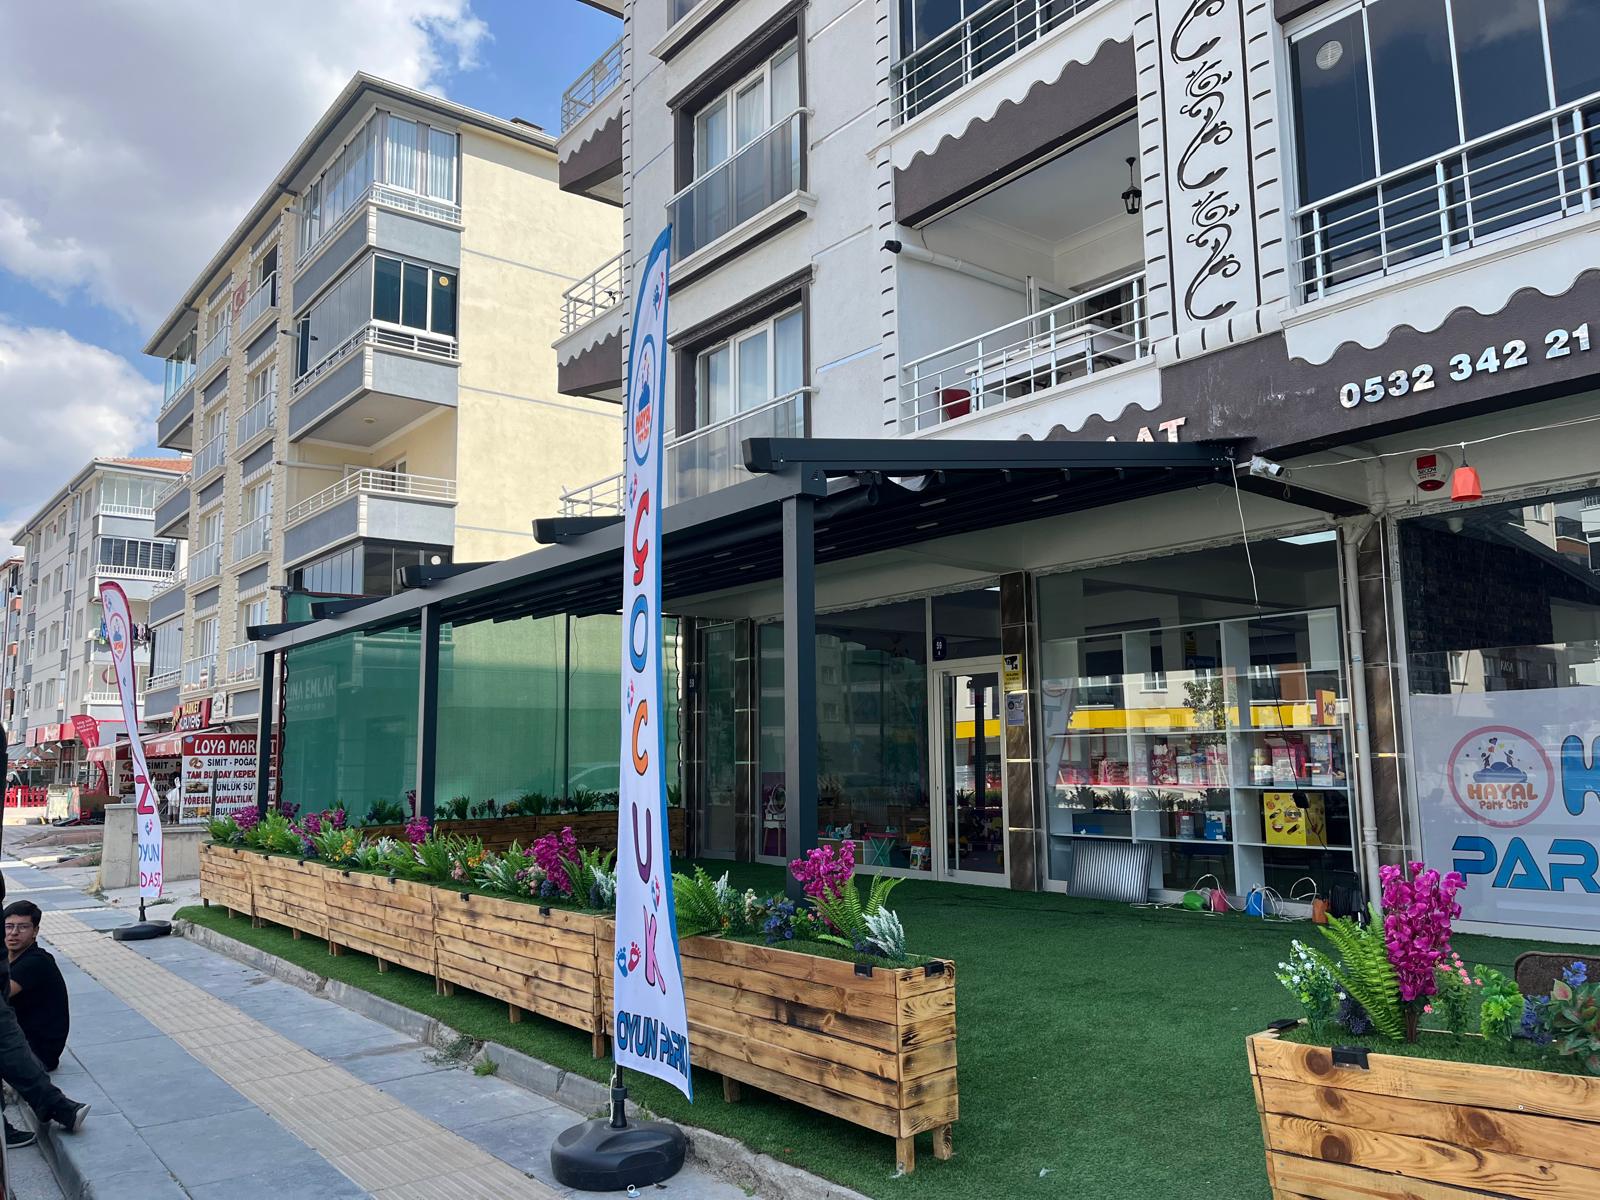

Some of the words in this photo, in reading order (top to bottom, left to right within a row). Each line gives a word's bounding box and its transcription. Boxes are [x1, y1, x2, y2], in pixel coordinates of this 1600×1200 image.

[1339, 363, 1435, 408] 0532
[1449, 339, 1528, 381] 342
[1544, 322, 1591, 359] 21
[194, 739, 226, 754] LOYA
[233, 756, 257, 767] POĞAÇ
[187, 771, 202, 779] TAM
[204, 770, 232, 779] BUDAY
[233, 769, 257, 778] KEPEK
[216, 781, 241, 791] ÜNLÜK
[1466, 783, 1538, 800] HAYAL
[1479, 799, 1504, 810] Park
[1505, 799, 1529, 810] Cafe
[1451, 835, 1600, 894] PAR
[616, 1010, 659, 1061] OYUN
